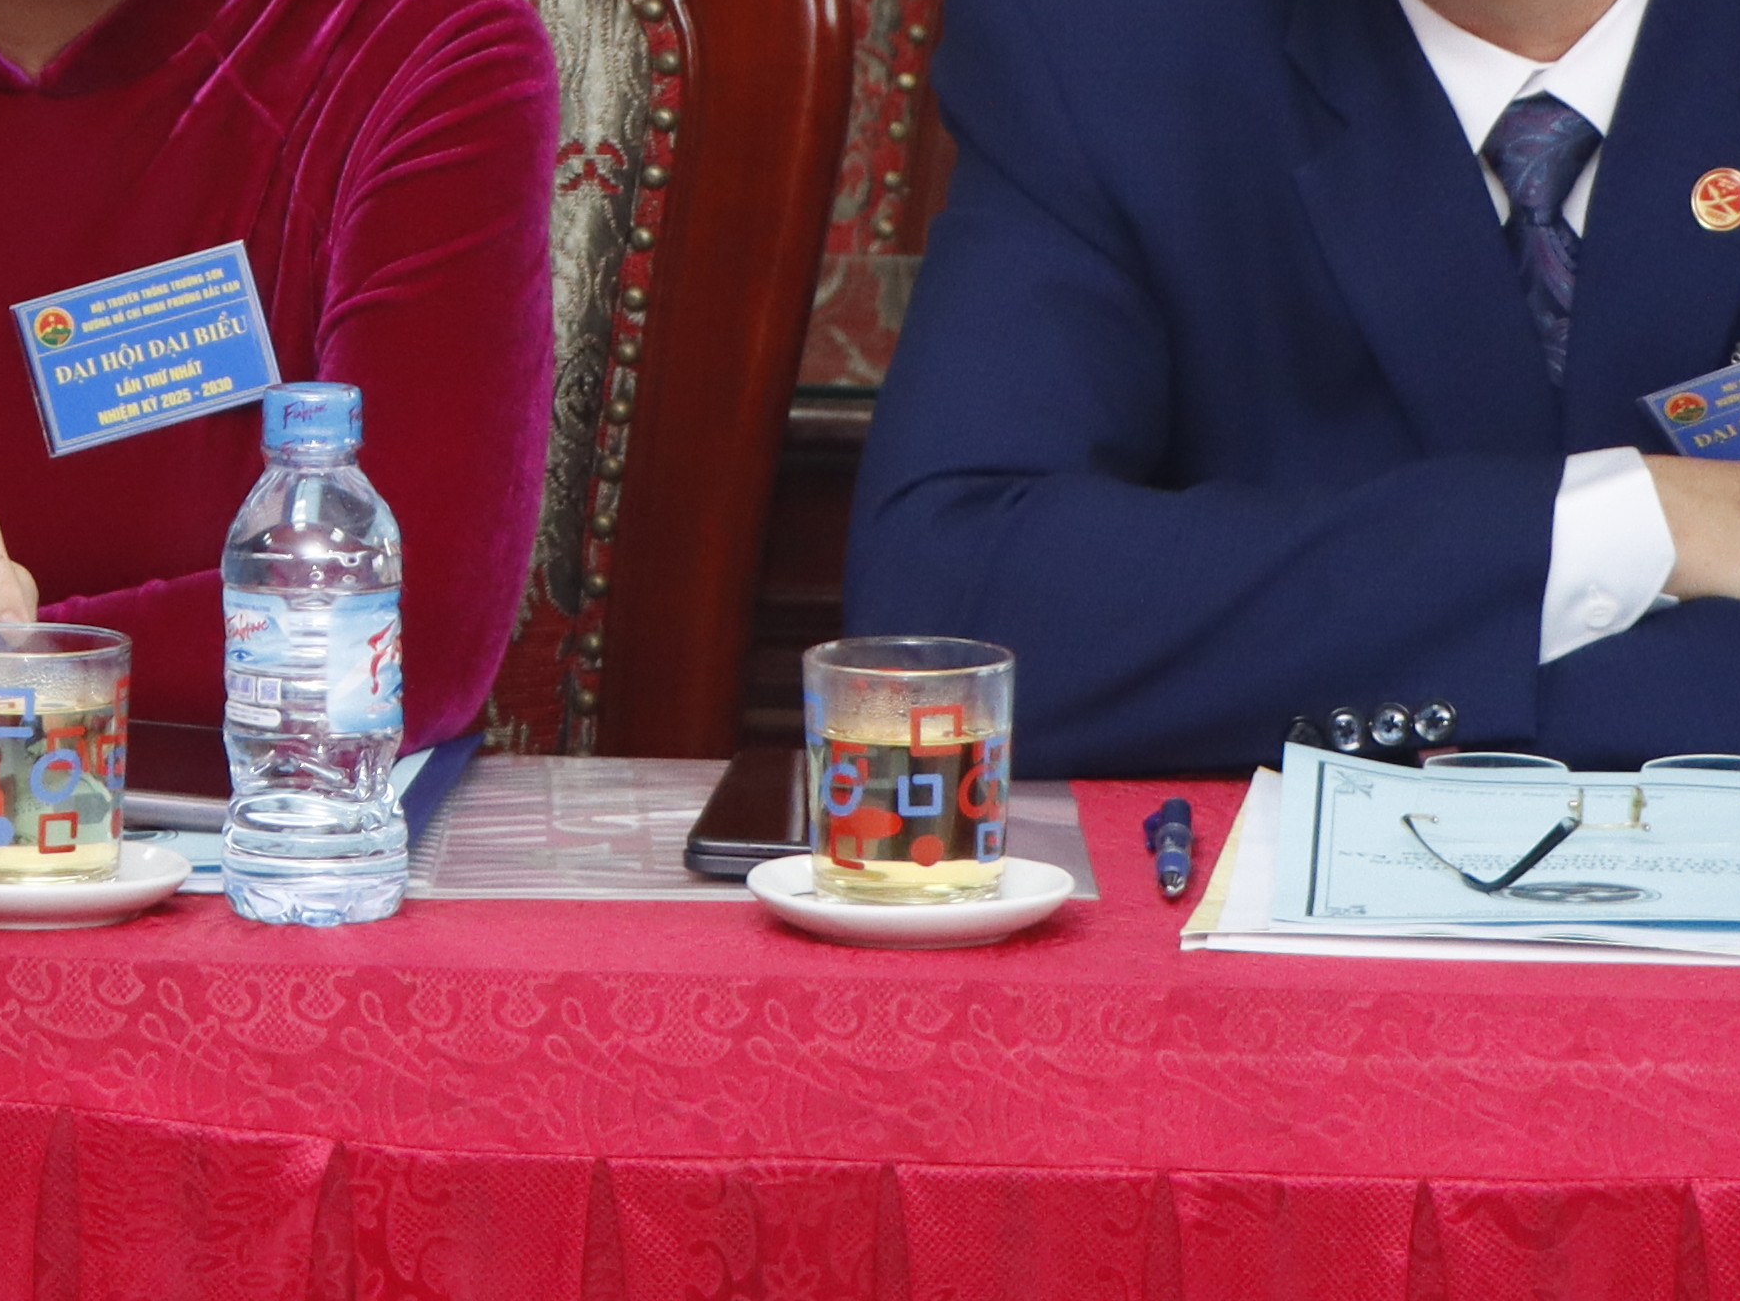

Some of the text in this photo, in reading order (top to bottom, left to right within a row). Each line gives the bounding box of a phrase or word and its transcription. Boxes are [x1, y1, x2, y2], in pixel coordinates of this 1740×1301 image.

[56, 312, 248, 384] ĐẠI HỘI ĐẠI BIỂU
[168, 360, 202, 381] NHẤT
[98, 403, 141, 425] NHIỆM
[160, 388, 193, 408] 2025
[201, 377, 233, 397] 2030
